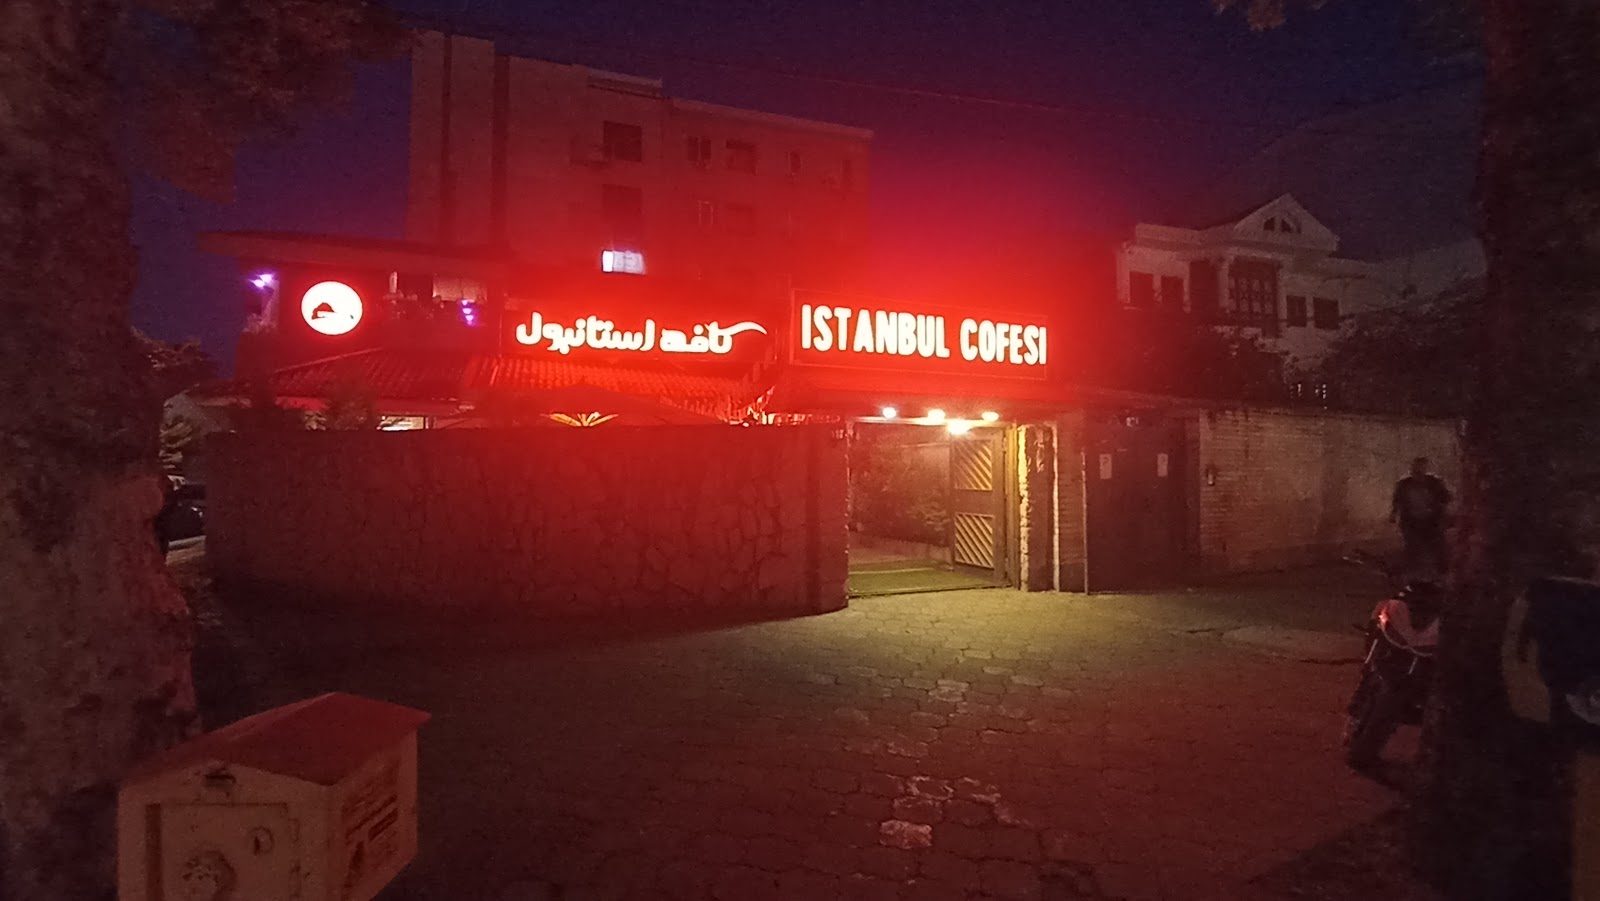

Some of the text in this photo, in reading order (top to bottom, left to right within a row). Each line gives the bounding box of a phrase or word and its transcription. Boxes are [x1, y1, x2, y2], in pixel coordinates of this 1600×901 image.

[516, 311, 767, 355] کافه استانبول
[801, 304, 1047, 365] ISTANBUL COFESI
